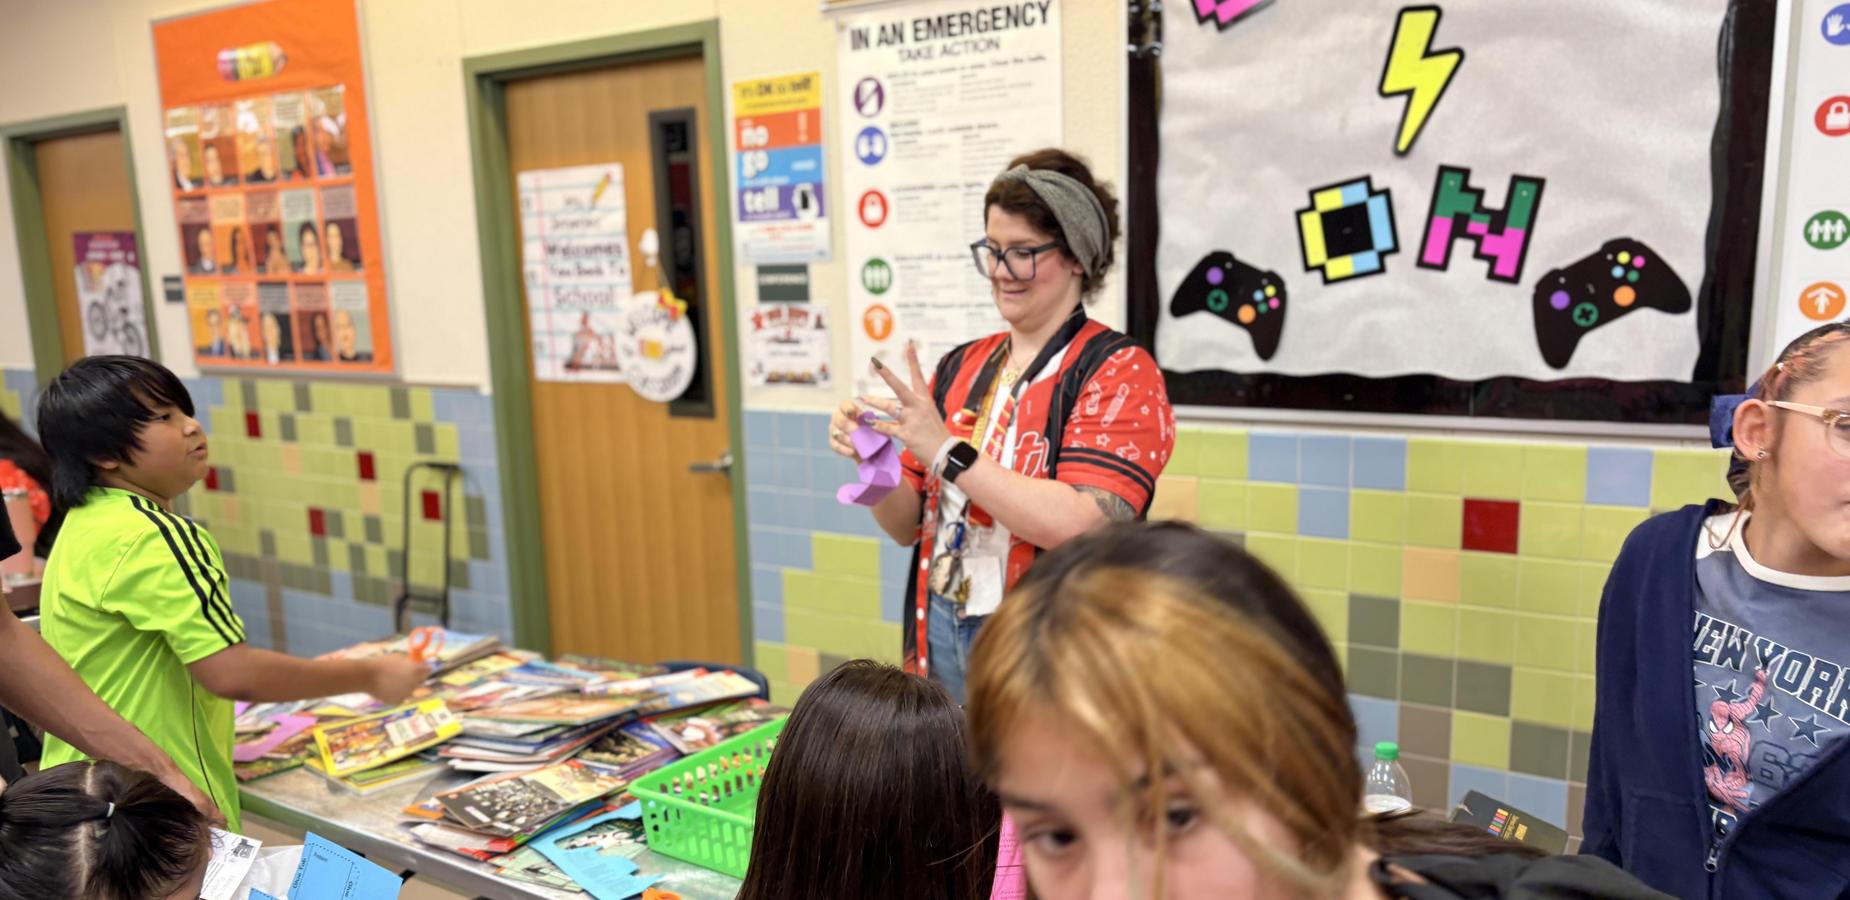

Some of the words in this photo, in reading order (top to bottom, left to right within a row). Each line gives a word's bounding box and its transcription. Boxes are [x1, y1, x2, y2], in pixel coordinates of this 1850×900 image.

[851, 28, 870, 50] IN
[877, 23, 904, 48] AN
[912, 0, 1051, 43] EMERGENCY
[899, 46, 935, 62] TAKE
[940, 38, 1000, 58] ACTION
[741, 125, 769, 148] no
[742, 149, 769, 179] go
[743, 185, 780, 214] tell
